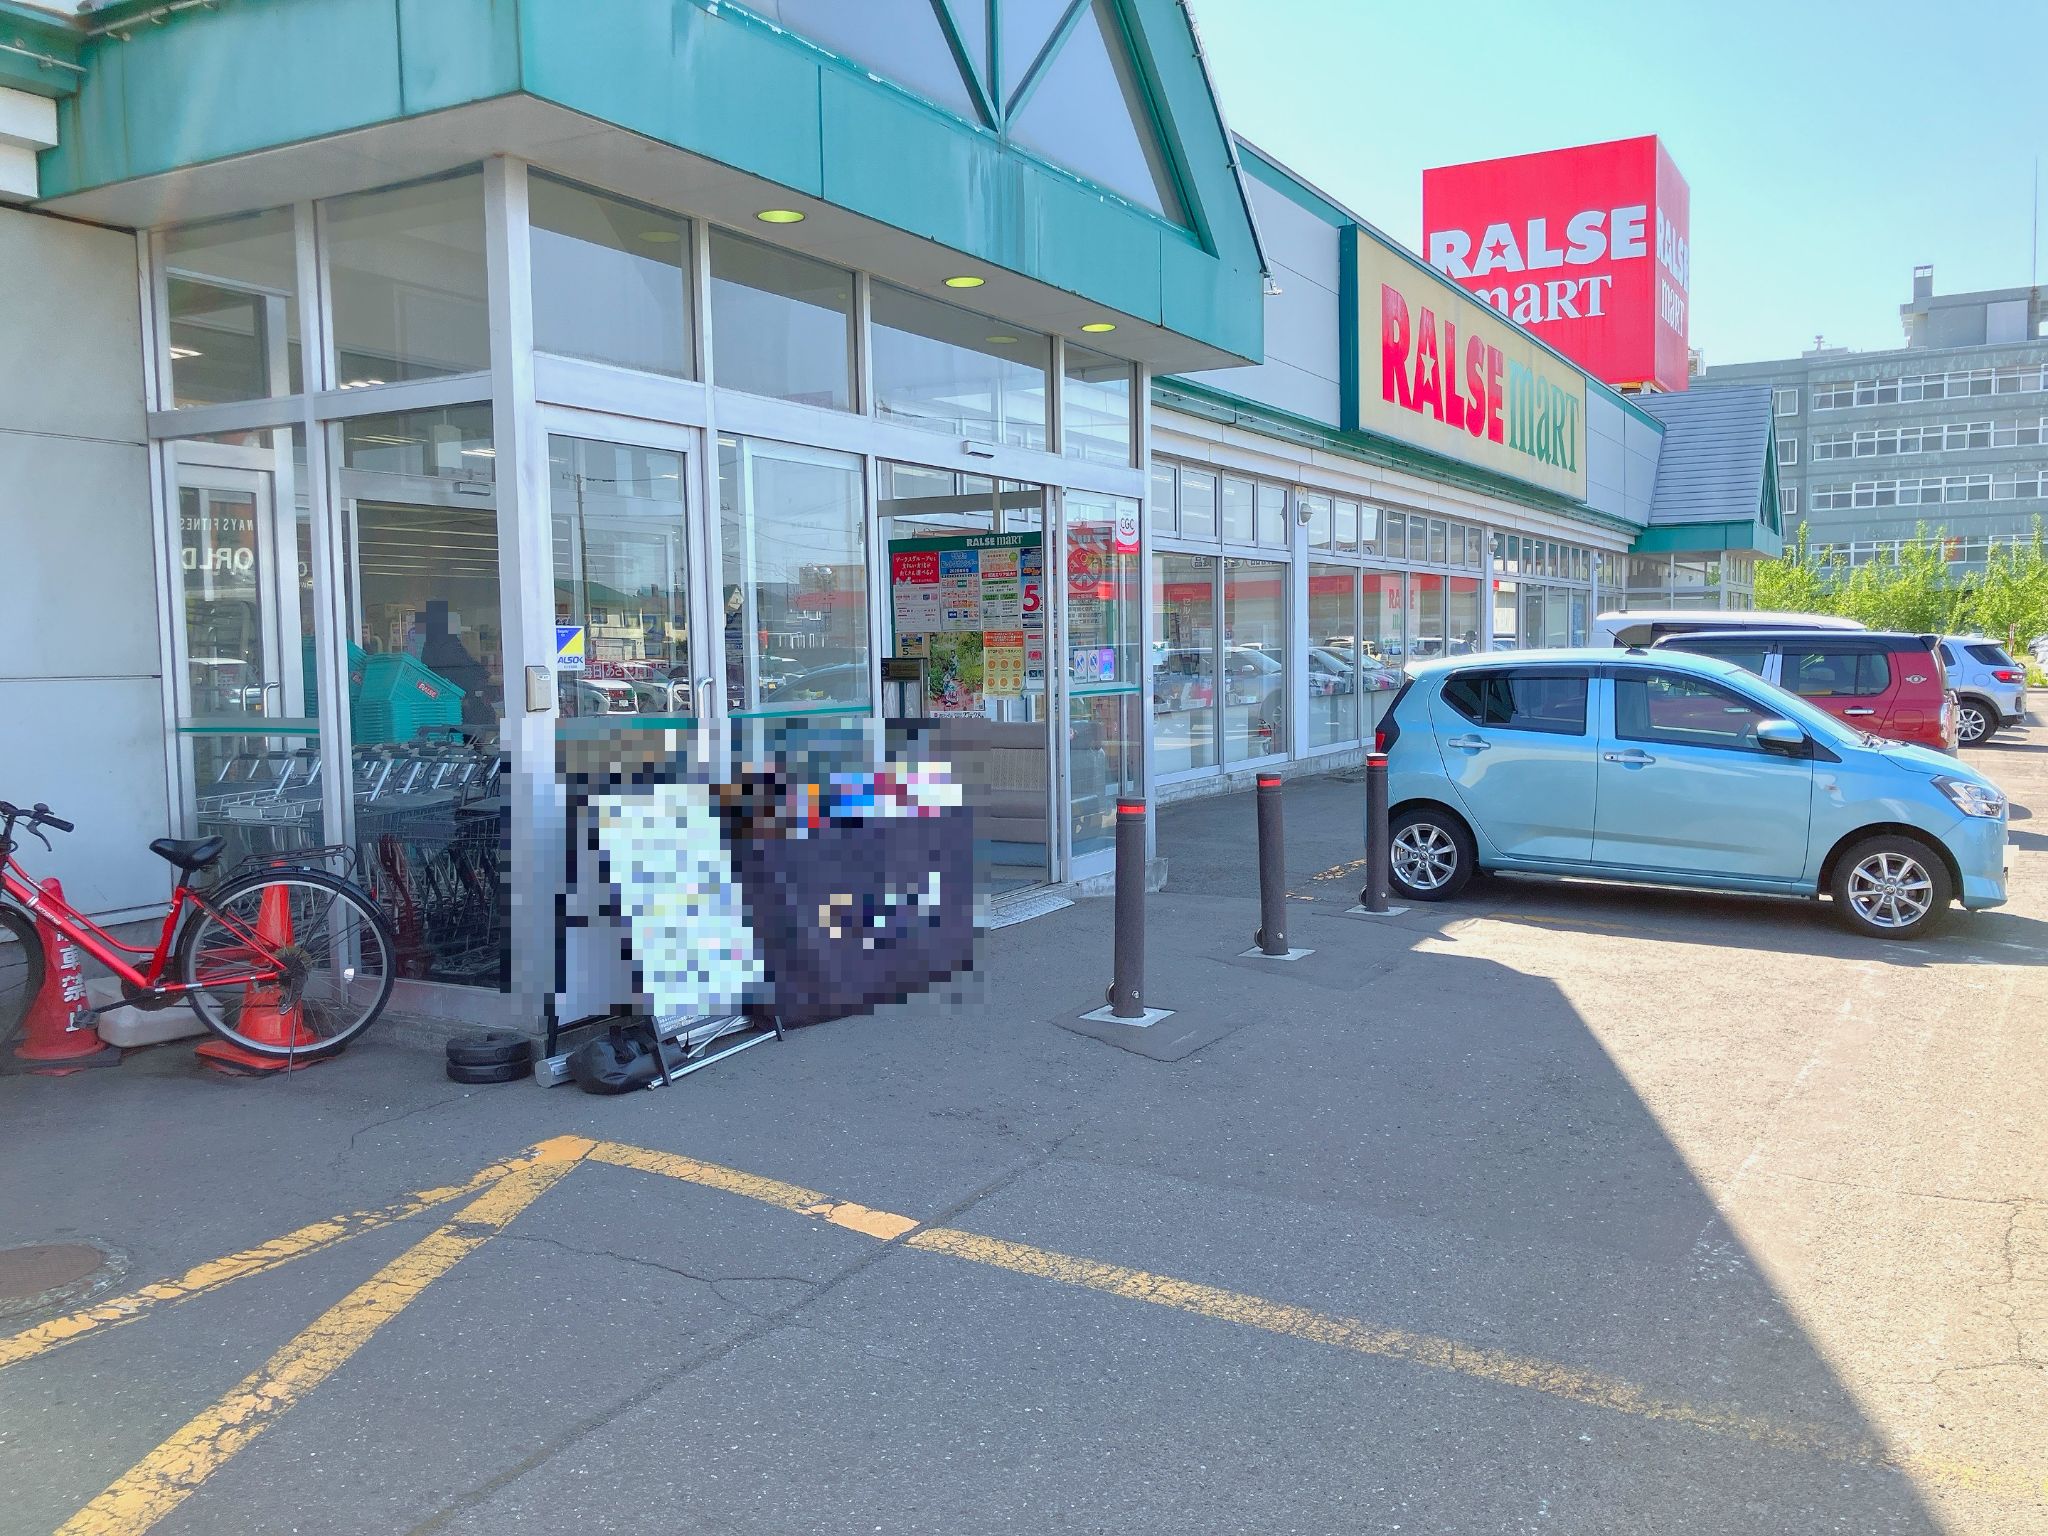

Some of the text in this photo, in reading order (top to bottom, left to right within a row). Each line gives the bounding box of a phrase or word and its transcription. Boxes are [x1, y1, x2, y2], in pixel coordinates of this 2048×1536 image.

[1429, 205, 1647, 279] RALSE
[1382, 283, 1504, 445] RALSE
[1120, 517, 1135, 530] CGC
[966, 537, 995, 547] RALSE
[1022, 584, 1040, 612] 5
[1388, 588, 1415, 610] RAE
[557, 656, 584, 664] ALSOK
